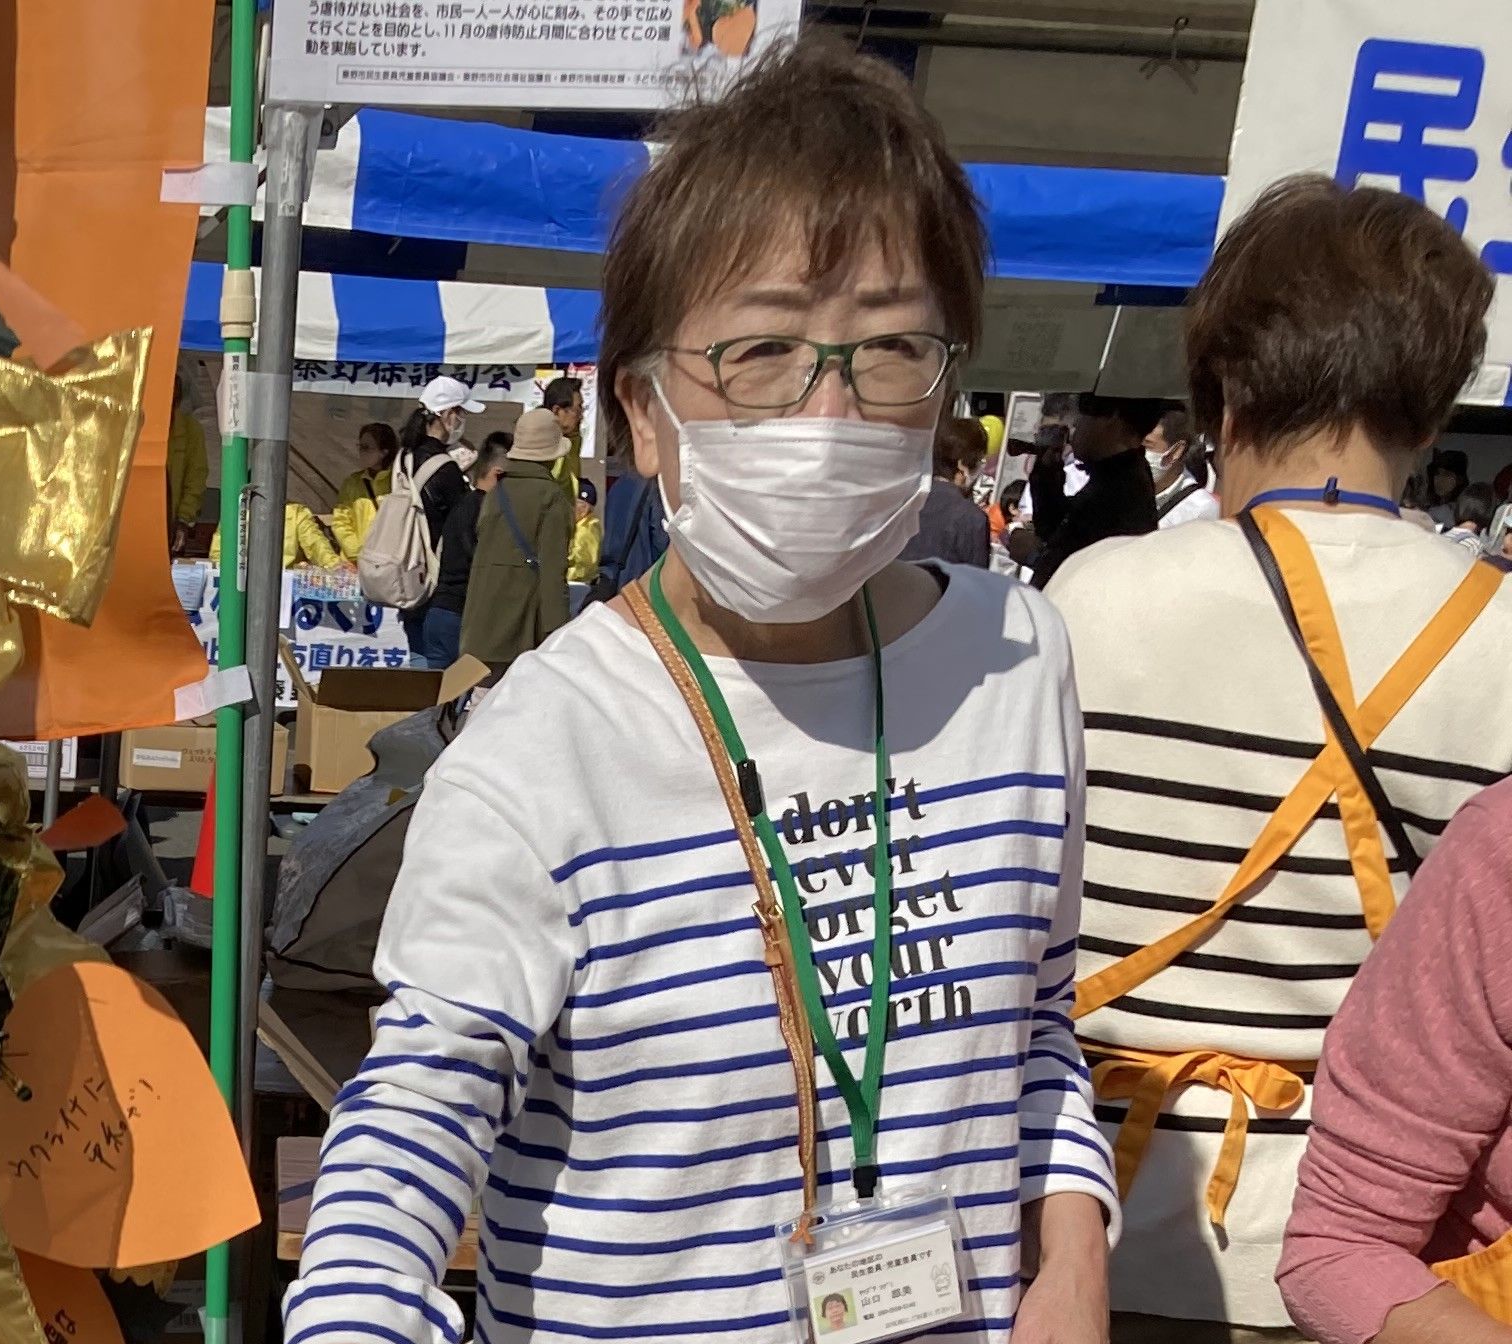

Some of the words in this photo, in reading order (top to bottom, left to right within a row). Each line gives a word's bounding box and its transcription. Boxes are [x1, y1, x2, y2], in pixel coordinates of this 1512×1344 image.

[305, 39, 427, 57] 動を実施しています。
[832, 980, 973, 1042] orth
[8, 1077, 106, 1180] ウクライナに
